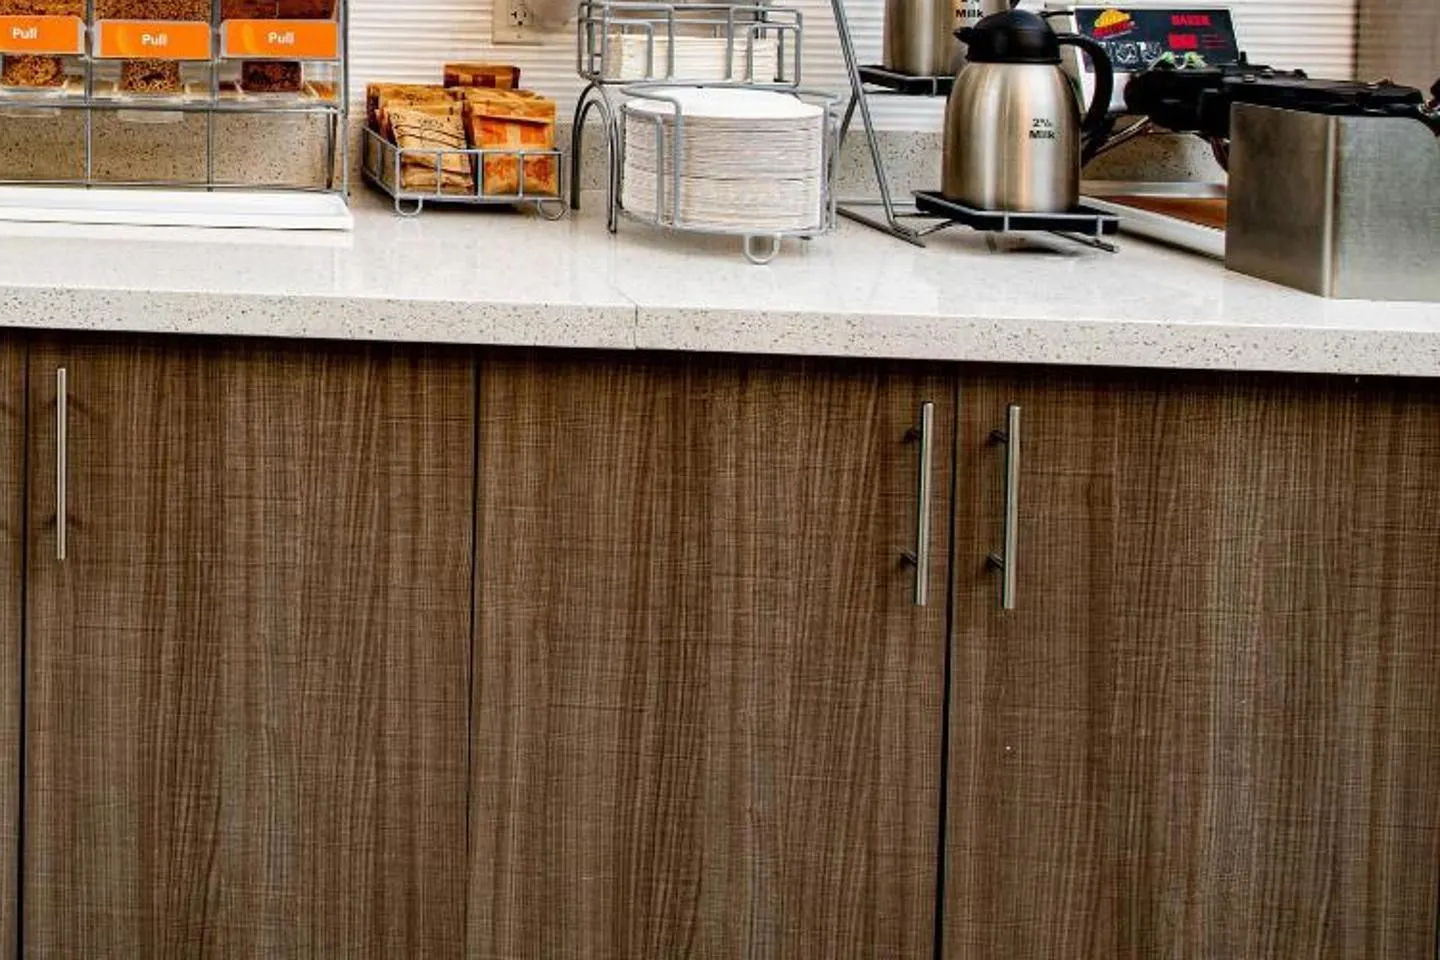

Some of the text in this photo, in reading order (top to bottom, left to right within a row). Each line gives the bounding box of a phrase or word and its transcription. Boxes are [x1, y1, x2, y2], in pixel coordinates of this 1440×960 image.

[955, 8, 984, 18] Milk
[11, 26, 38, 40] Pull
[267, 31, 295, 44] Pull
[141, 33, 168, 47] Pull
[1032, 118, 1053, 128] 2%
[1028, 129, 1056, 139] Milk
